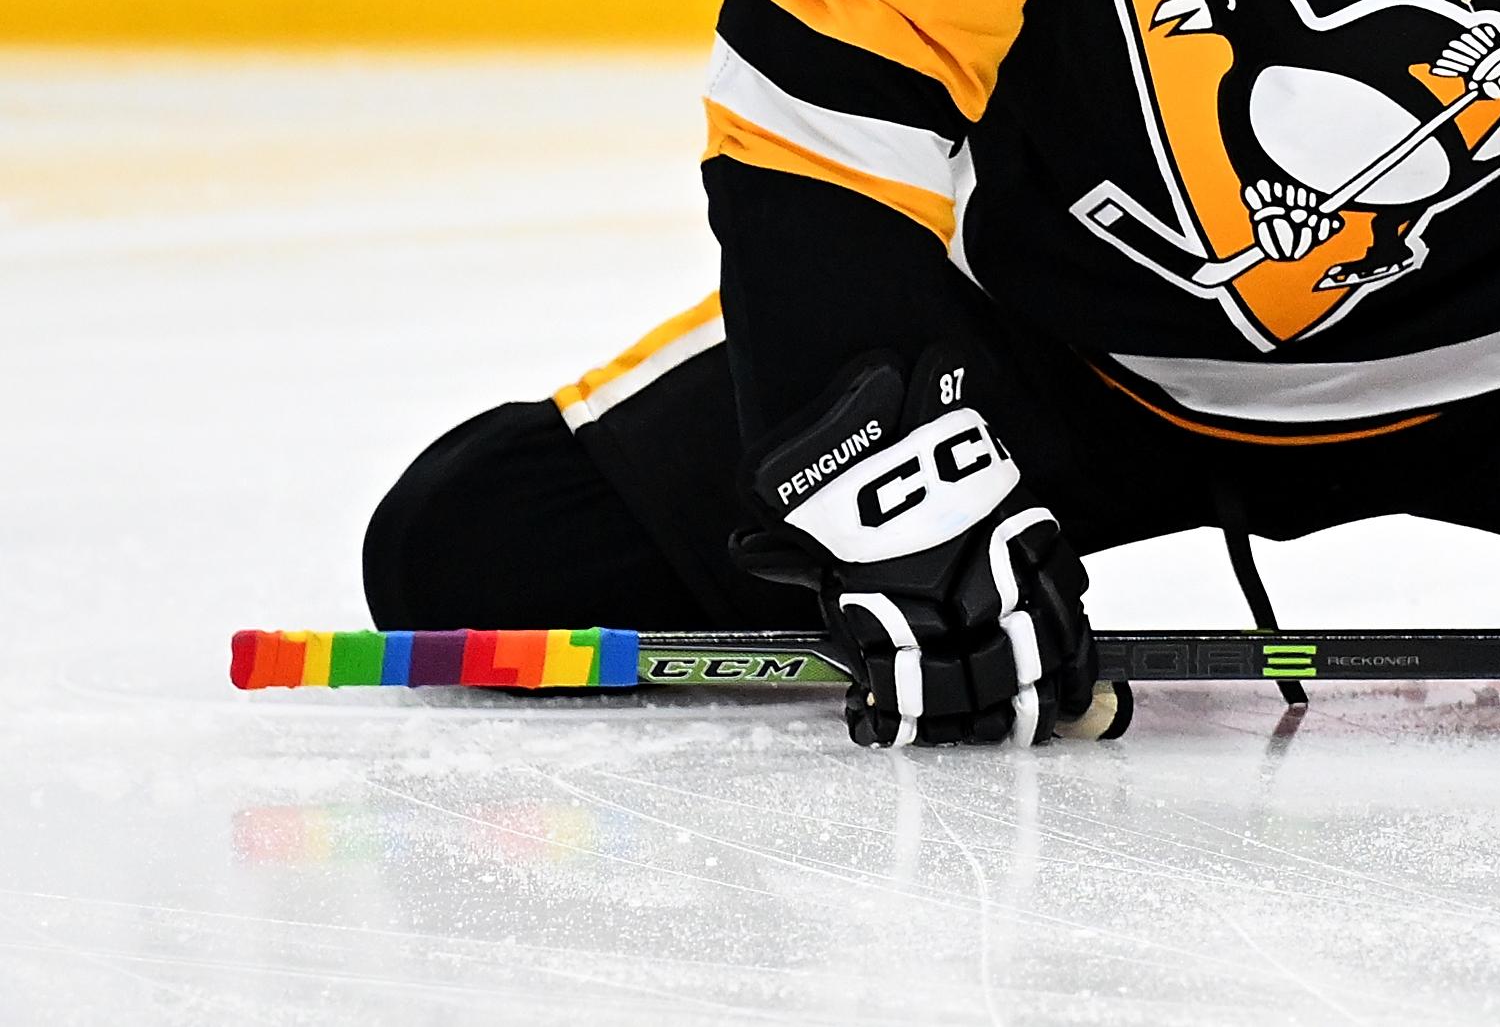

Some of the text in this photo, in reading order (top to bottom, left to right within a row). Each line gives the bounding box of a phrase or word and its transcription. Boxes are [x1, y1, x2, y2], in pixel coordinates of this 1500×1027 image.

[939, 367, 965, 405] 87
[776, 419, 883, 506] PENGUINS
[856, 425, 1010, 529] CC
[647, 656, 808, 681] CCM
[1327, 656, 1420, 666] RECKONER
